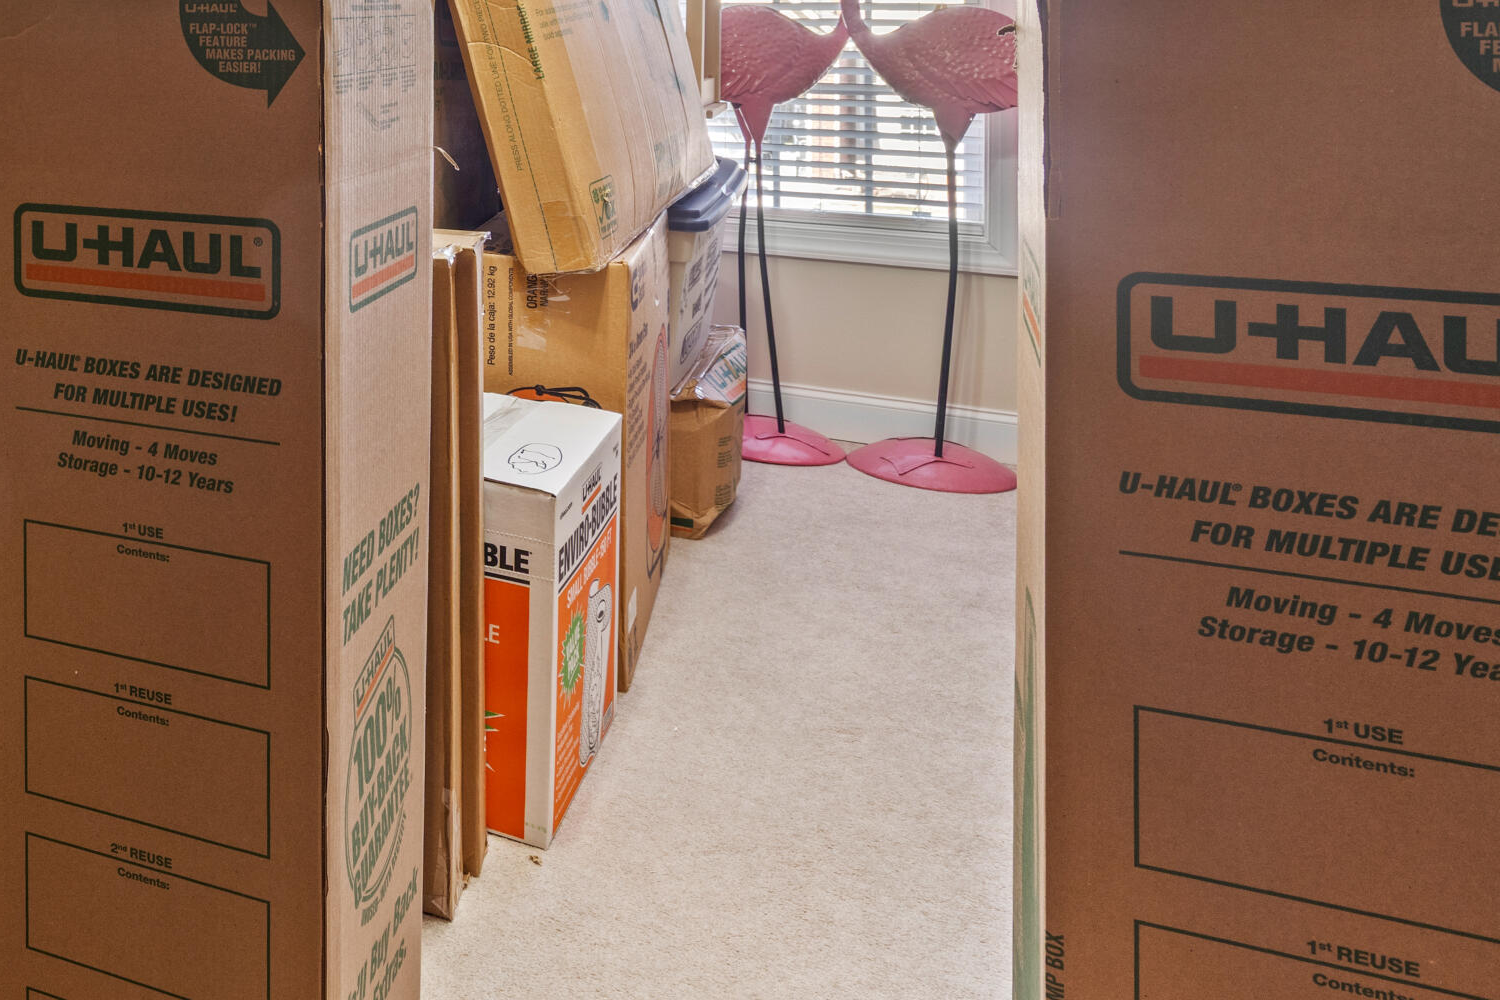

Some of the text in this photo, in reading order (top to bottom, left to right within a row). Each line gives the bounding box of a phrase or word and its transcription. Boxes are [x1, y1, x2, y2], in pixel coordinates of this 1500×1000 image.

[184, 3, 237, 13] U-HAUL
[199, 36, 248, 47] FEATURE
[205, 48, 296, 61] MAKES PACKING
[219, 61, 261, 73] EASIER!
[526, 44, 546, 81] LARGE
[354, 221, 414, 278] U-HAUL
[487, 265, 497, 366] Peso de la caja: 12.92 kg
[1150, 295, 1500, 378] U-HAU
[83, 355, 141, 381] BOXES
[145, 361, 183, 386] ARE
[186, 366, 283, 397] DESIGNED
[54, 381, 238, 423] FOR MULTIPLE USES!
[72, 429, 218, 467] Moving 4 Moves
[58, 452, 235, 494] Storage 10-12 Years
[559, 473, 618, 578] ENVIRO-BUBBLE
[1248, 486, 1360, 520] BOXES
[1368, 500, 1442, 531] ARE
[122, 521, 165, 540] 1st USE
[342, 481, 420, 598] NEED BOXES?
[1190, 519, 1428, 572] FOR MULTIPLE
[116, 543, 171, 563] Contents:
[343, 526, 420, 648] TAKE PLENTY!
[1225, 585, 1394, 630] Moving 4
[1197, 615, 1441, 673] Storage 10-12
[114, 682, 173, 706] 1st REUSE
[116, 706, 170, 727] Contents:
[353, 662, 402, 801] 100%
[1323, 717, 1405, 746] 1st USE
[1312, 748, 1417, 779] Contents:
[110, 842, 173, 869] 2nd REUSE
[116, 866, 170, 892] Contents:
[1045, 930, 1065, 971] BOX
[1306, 938, 1421, 978] 1st REUSE
